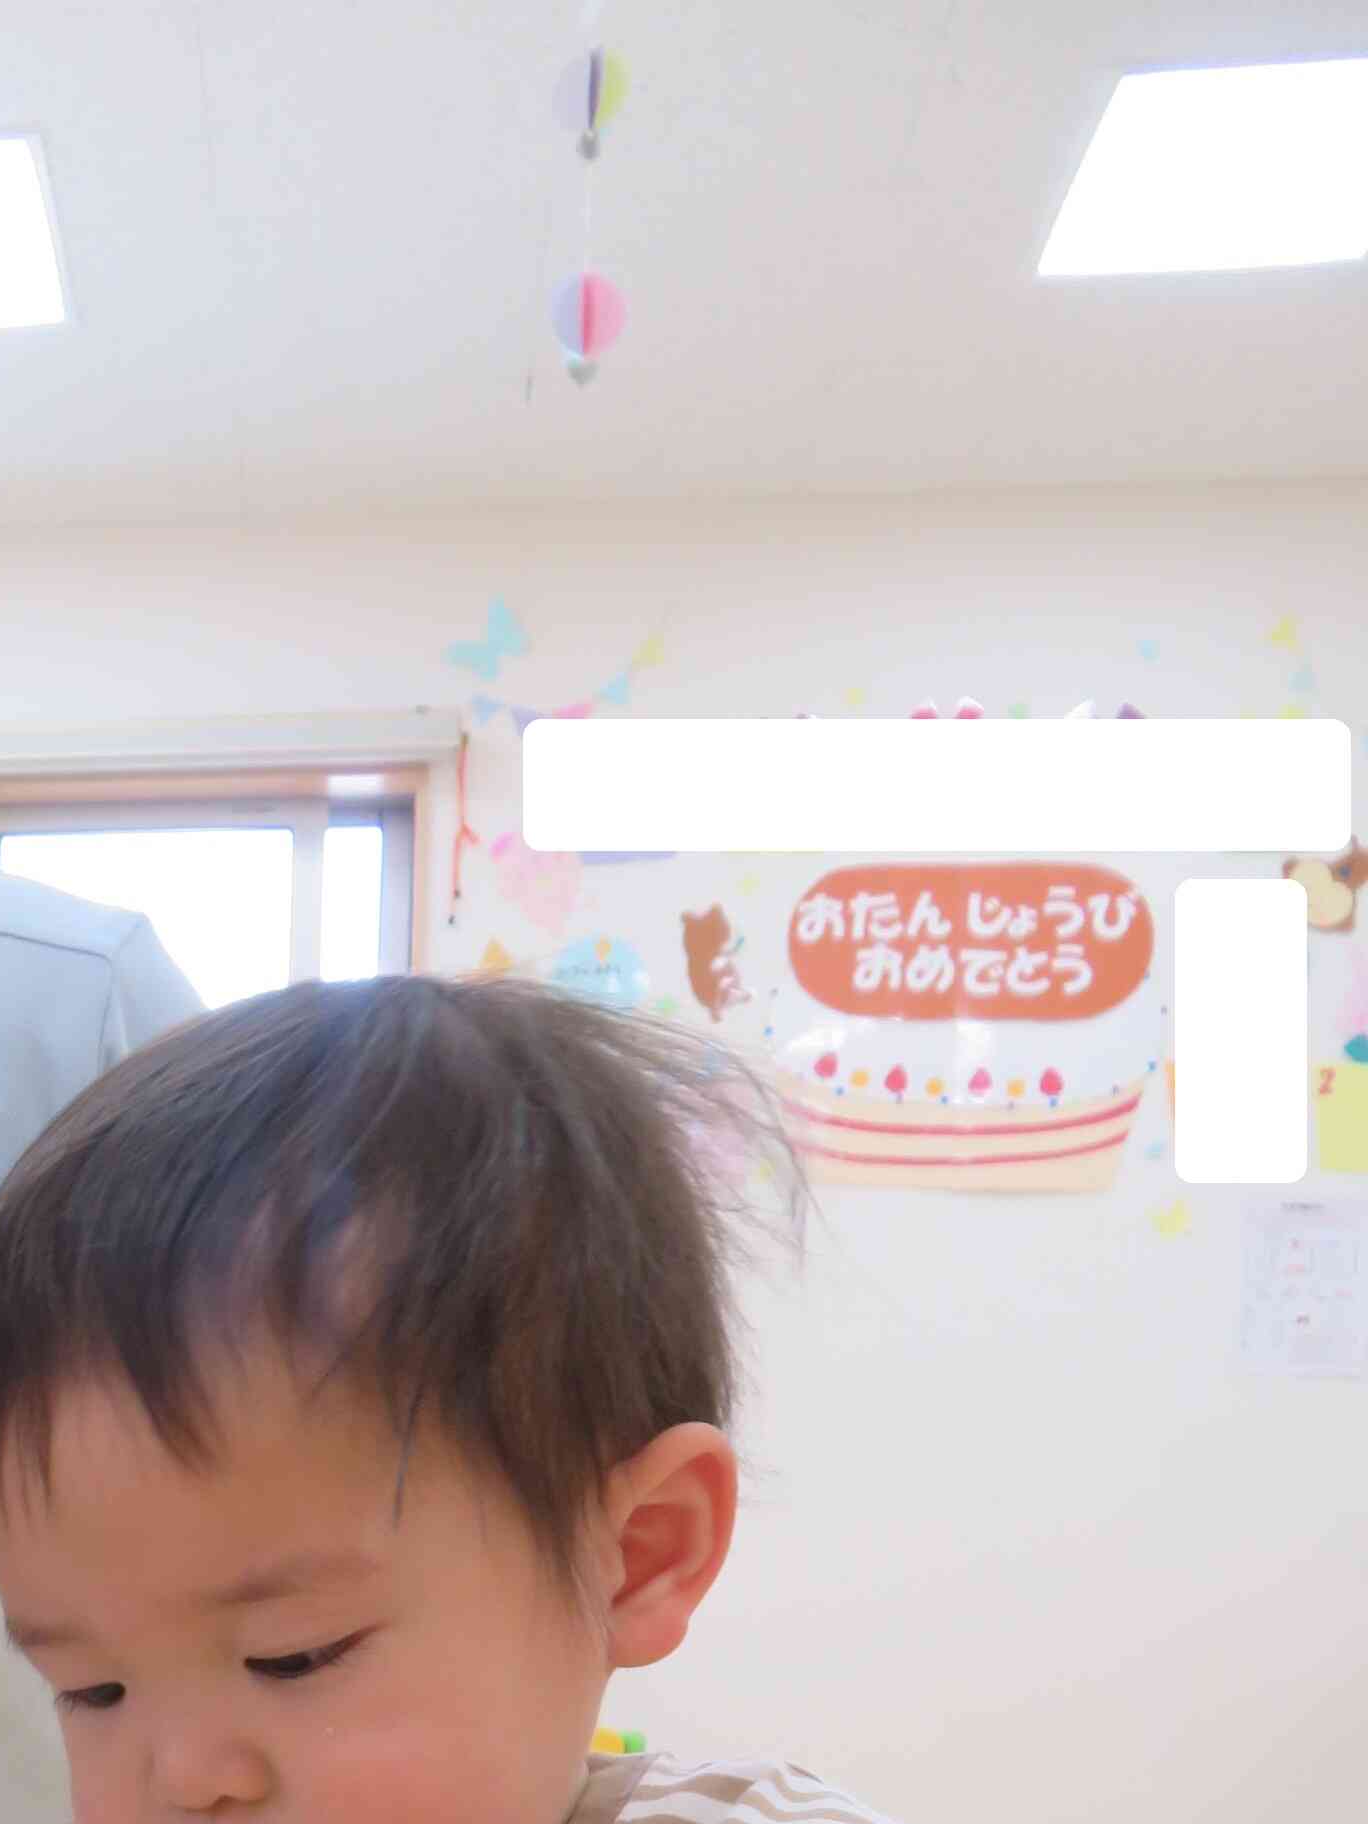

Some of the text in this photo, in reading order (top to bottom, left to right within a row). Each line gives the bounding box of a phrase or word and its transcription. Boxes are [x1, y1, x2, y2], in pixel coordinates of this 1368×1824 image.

[852, 943, 1093, 995] おめでとう
